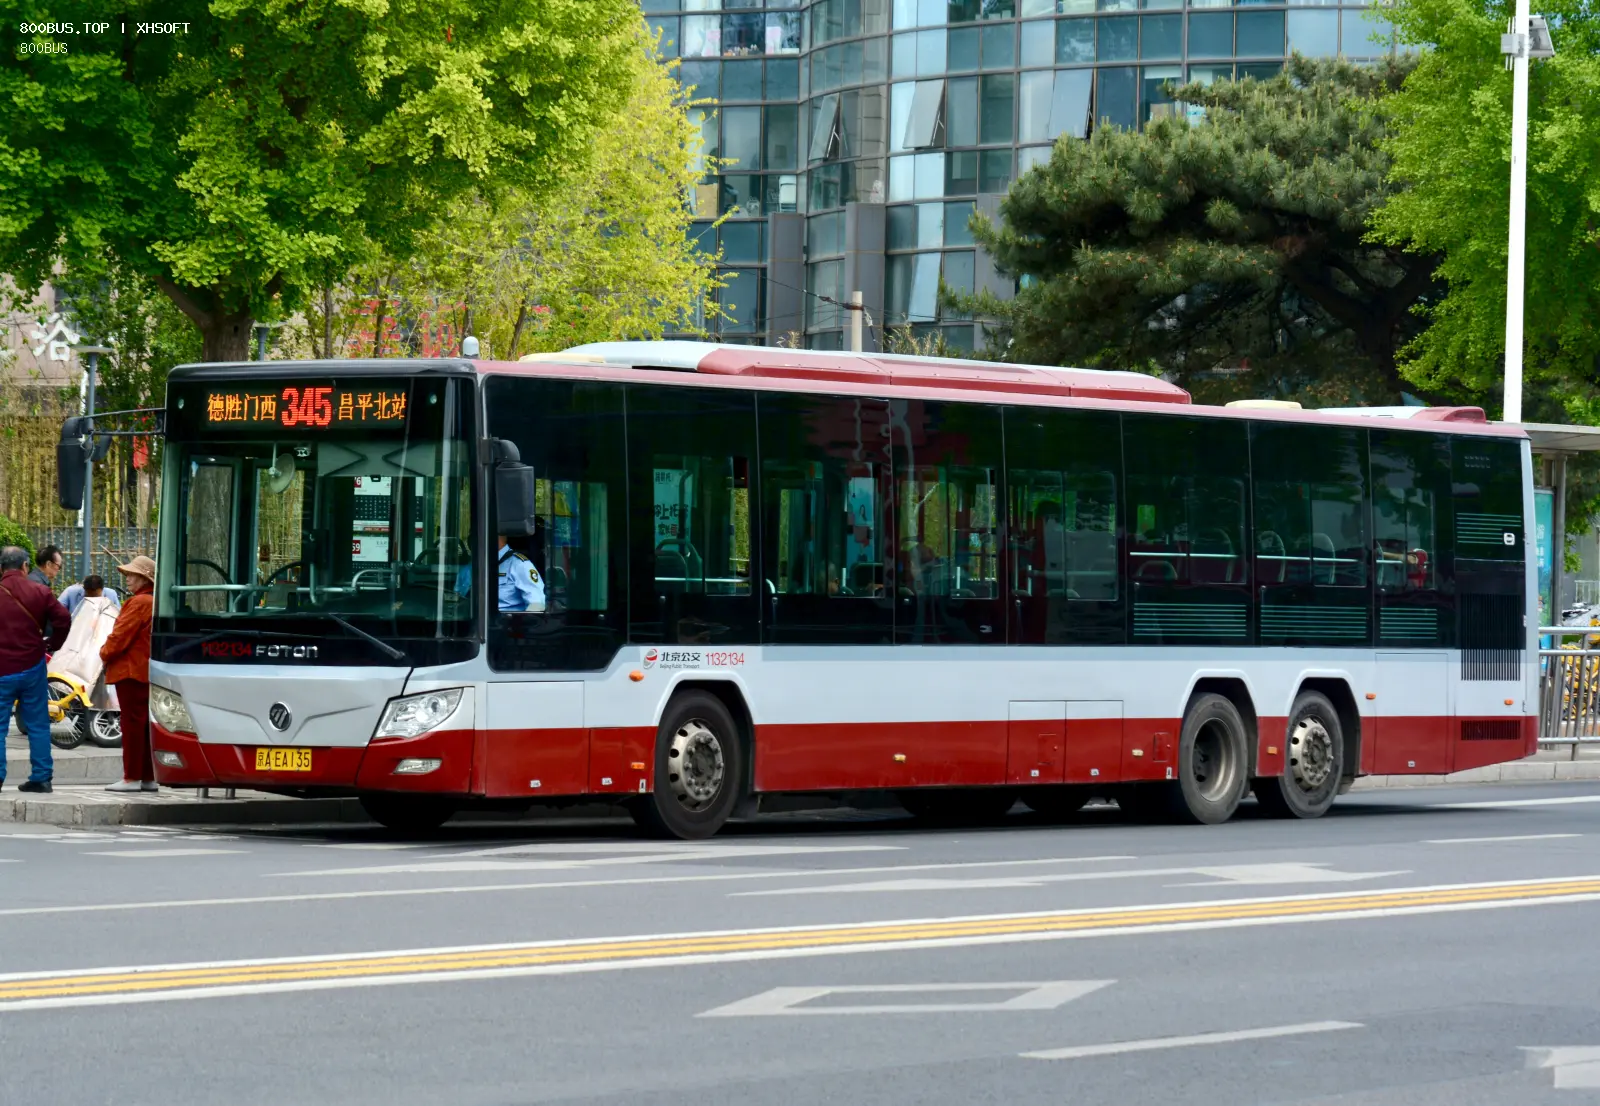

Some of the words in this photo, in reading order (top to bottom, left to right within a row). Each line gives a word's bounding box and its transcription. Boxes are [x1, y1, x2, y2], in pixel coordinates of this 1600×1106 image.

[207, 393, 277, 421] 德胜门西
[281, 387, 332, 426] 345
[338, 391, 407, 421] 昌平北站
[201, 641, 252, 657] 1132134
[660, 651, 701, 662] 北京公交
[705, 652, 745, 666] 1132134
